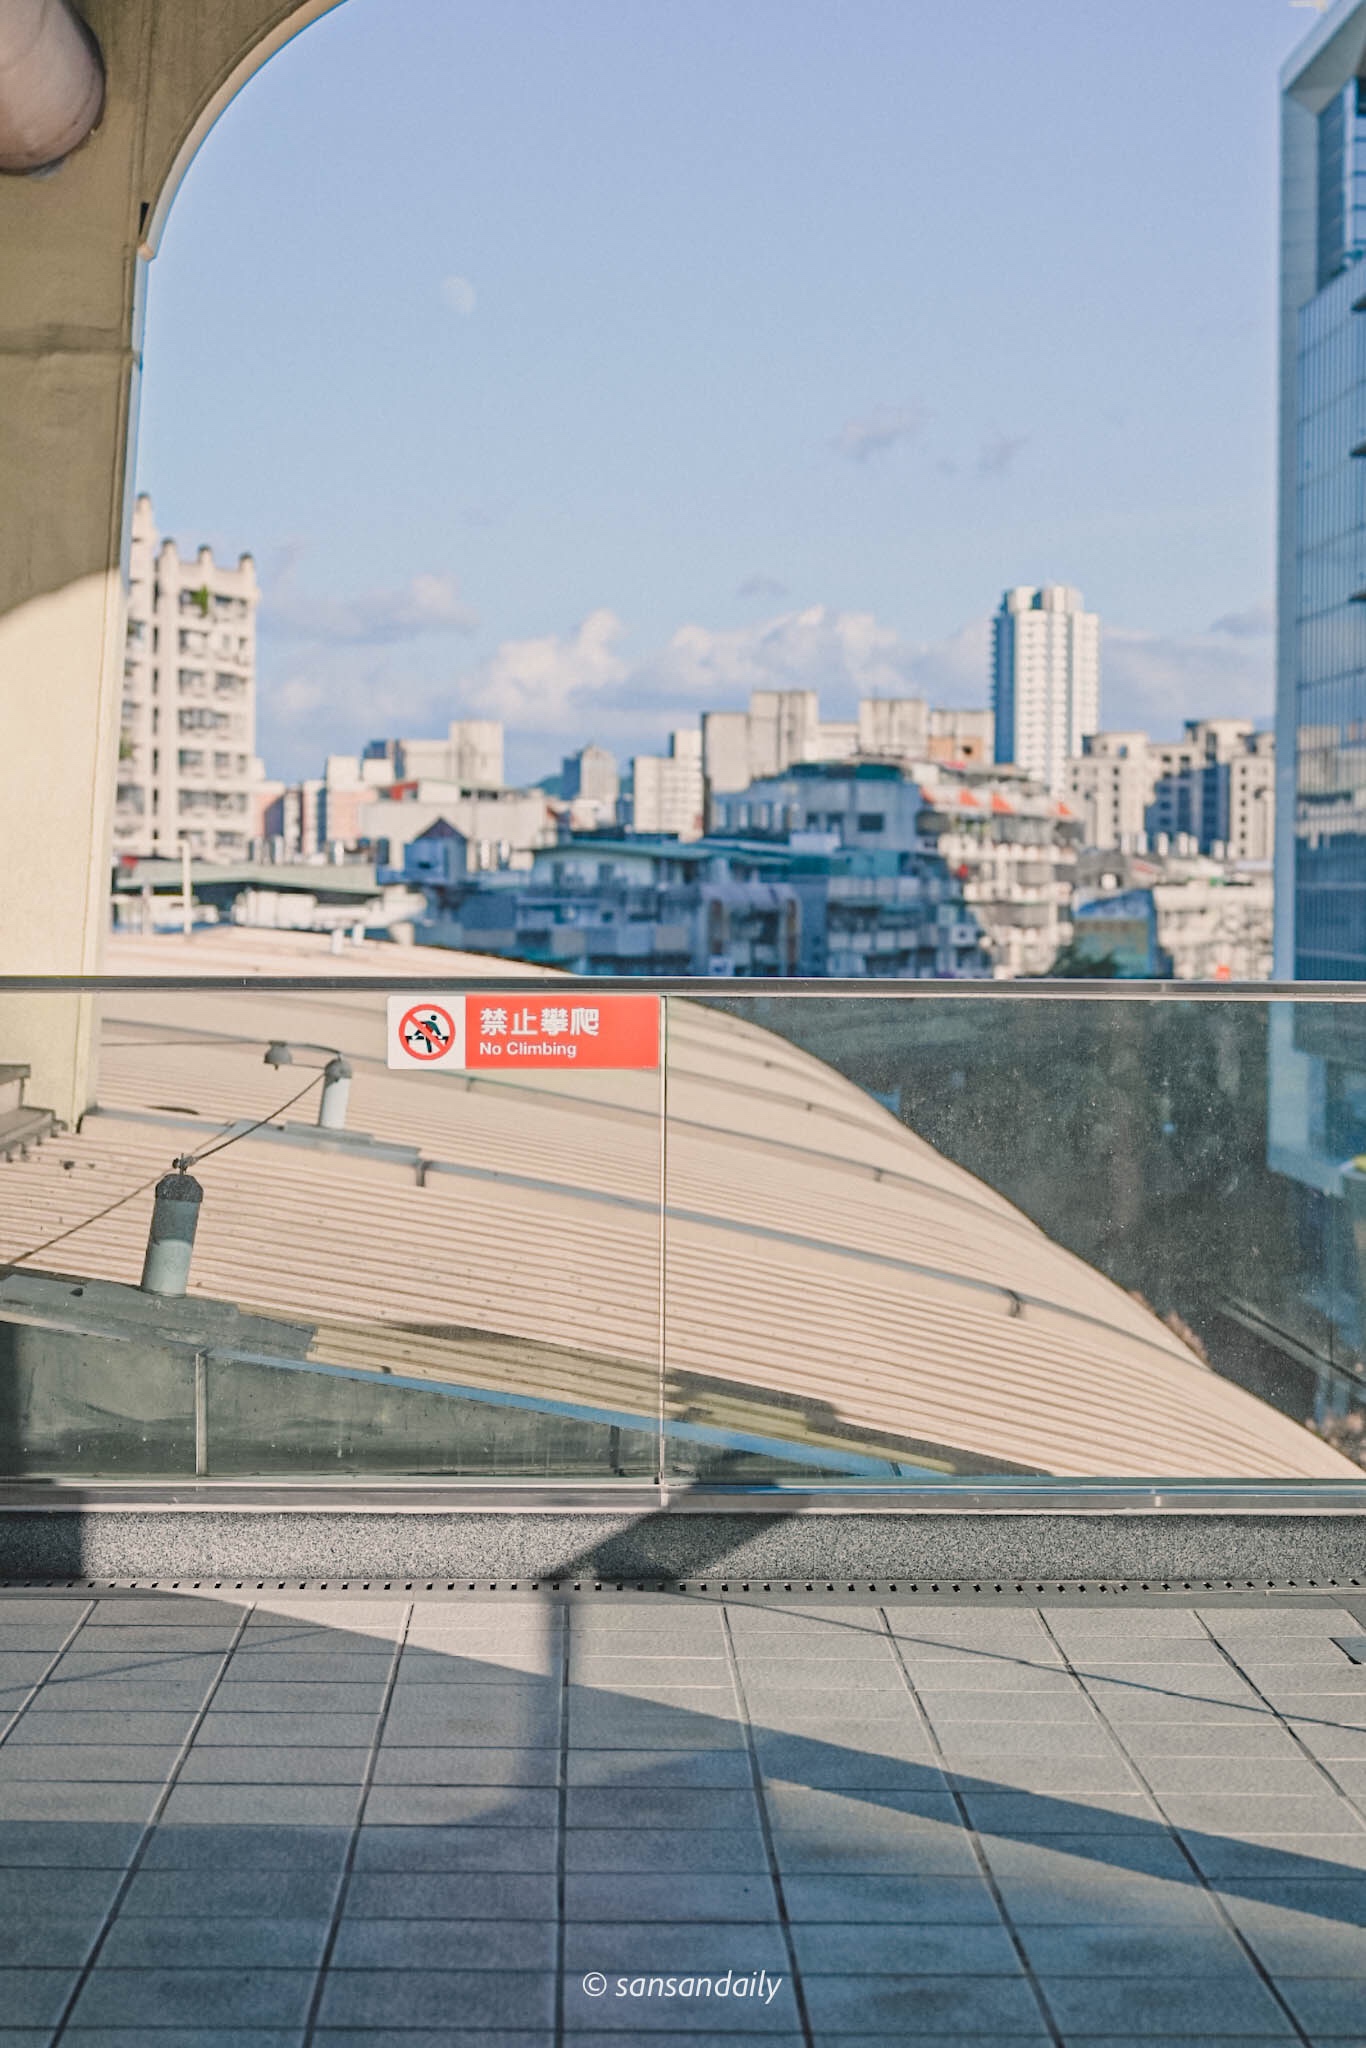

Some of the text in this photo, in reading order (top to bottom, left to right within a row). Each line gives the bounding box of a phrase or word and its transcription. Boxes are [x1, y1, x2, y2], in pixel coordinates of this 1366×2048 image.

[480, 1007, 599, 1036] 禁止攀爬
[479, 1041, 577, 1058] No Climbing
